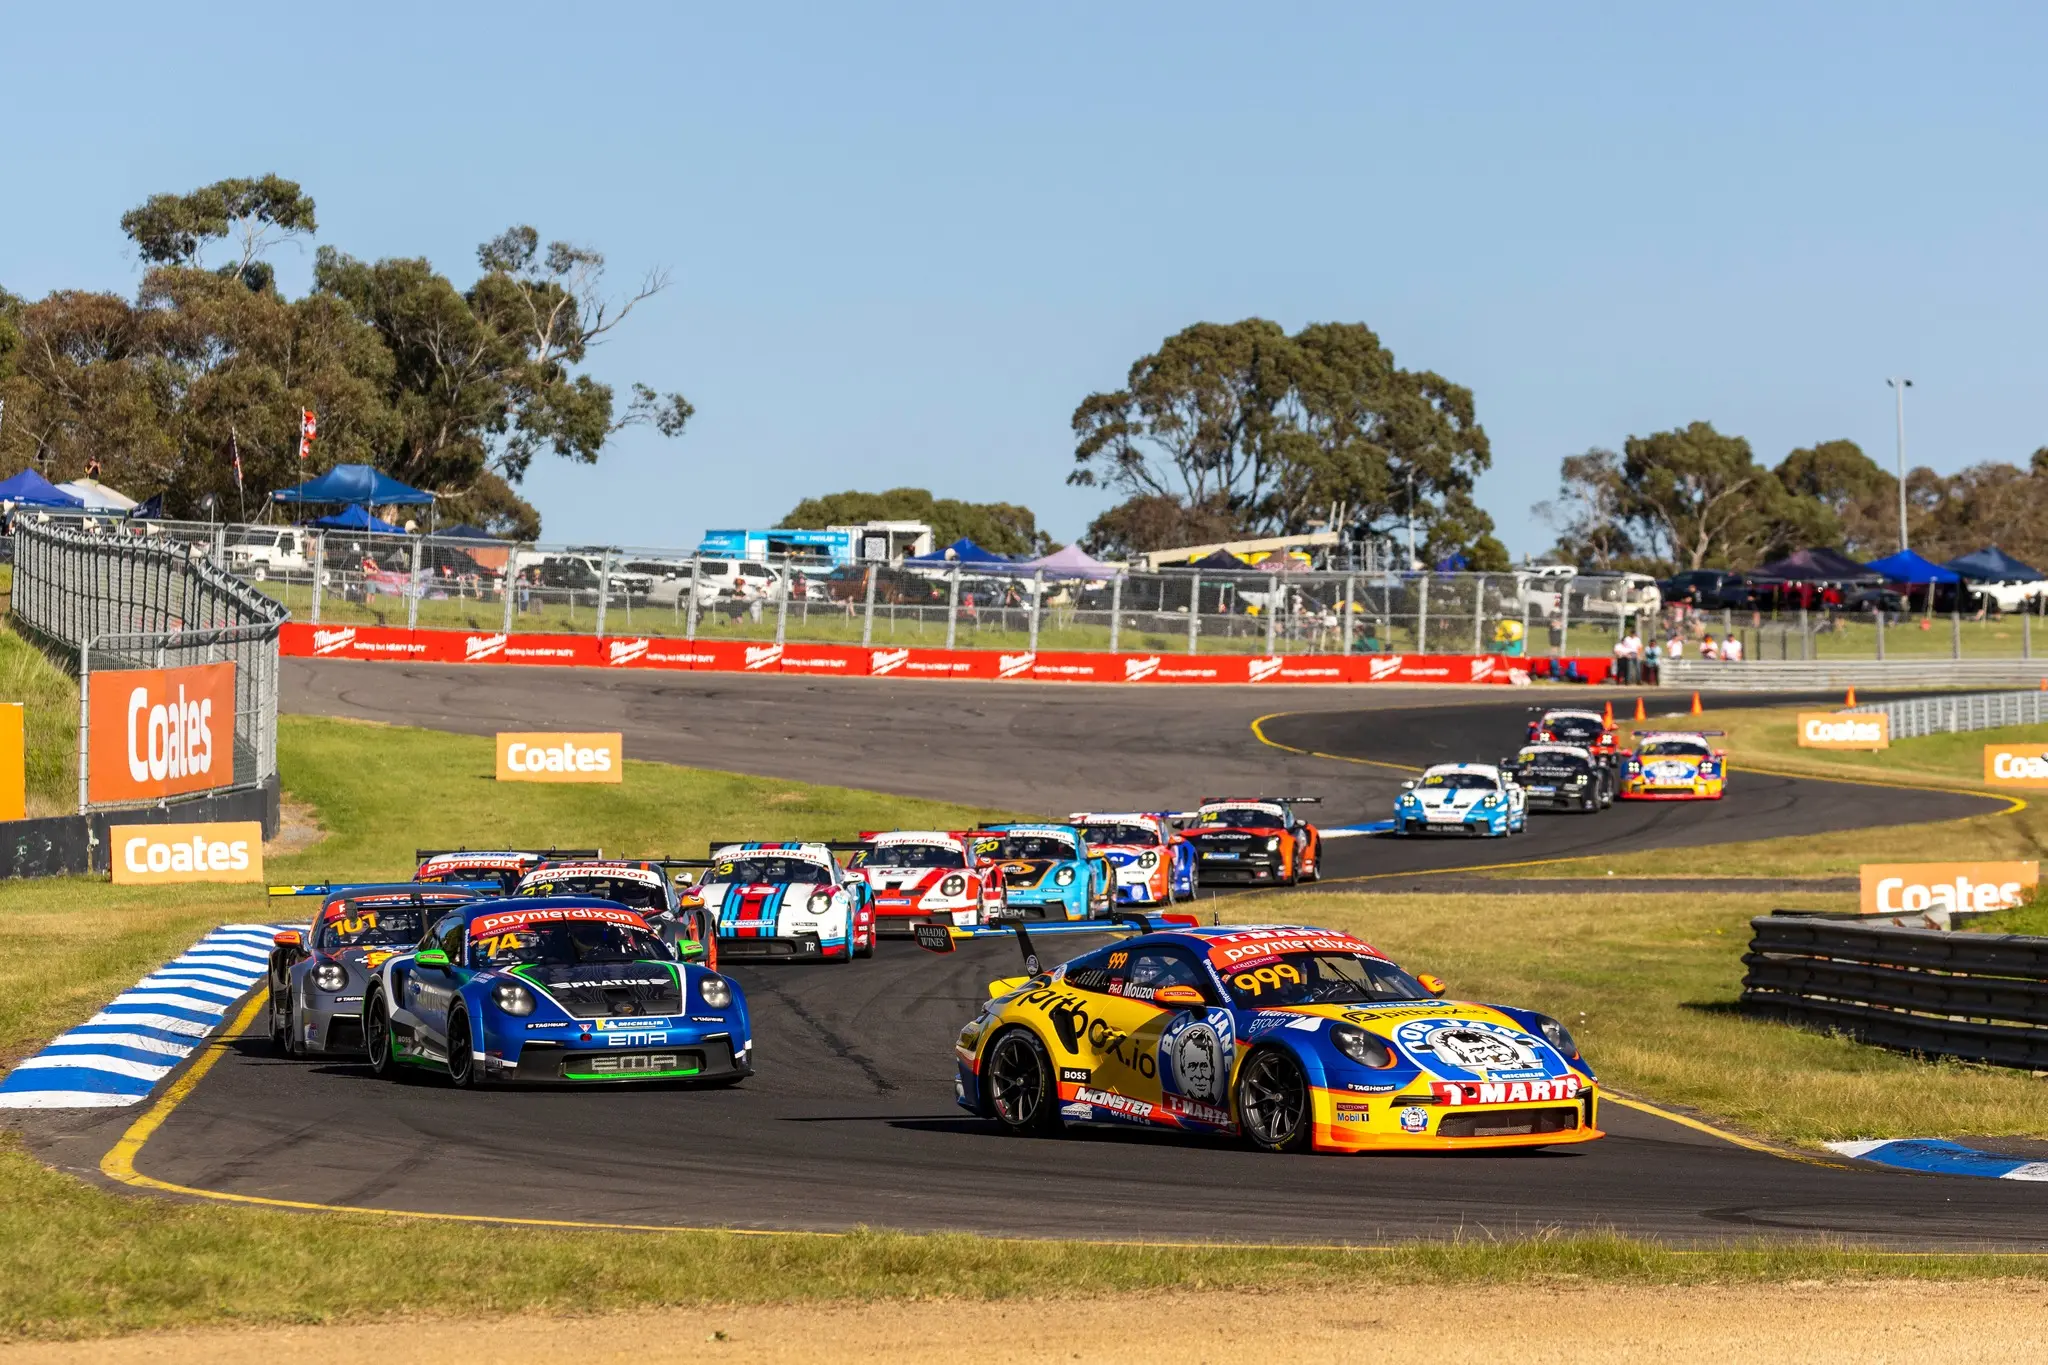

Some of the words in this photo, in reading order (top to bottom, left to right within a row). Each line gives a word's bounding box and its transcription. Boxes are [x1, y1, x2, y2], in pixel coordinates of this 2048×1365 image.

[128, 683, 212, 783] Coates
[1805, 719, 1881, 741] Coates
[508, 741, 611, 773] Coates
[1994, 752, 2048, 778] Coa
[125, 835, 249, 873] Coates
[720, 850, 818, 861] paynterdixon
[976, 841, 999, 854] 20
[533, 866, 649, 881] paynterdixon
[638, 880, 657, 890] Cook
[740, 886, 775, 895] 13
[1876, 875, 2024, 914] Coates
[330, 913, 377, 936] 101
[484, 908, 633, 930] paynterdixon
[606, 921, 649, 933] Patterson
[917, 926, 947, 938] AMADIO
[478, 932, 522, 958] 74
[805, 941, 815, 952] TR
[920, 936, 945, 948] WINES
[1224, 937, 1375, 963] paynterdixon
[1107, 952, 1129, 970] 999
[570, 978, 651, 989] PILATUS
[1234, 964, 1301, 997] 999
[1017, 988, 1157, 1079] pitbox.io
[1248, 1018, 1287, 1034] group
[608, 1032, 667, 1046] EMA
[591, 1054, 677, 1071] EMA
[1064, 1070, 1087, 1080] BOSS
[1501, 1071, 1545, 1079] MICHELIN
[1443, 1077, 1578, 1106] T-MARTS
[1074, 1086, 1154, 1118] MONSTER
[1110, 1110, 1151, 1126] WHEELS
[1169, 1096, 1230, 1127] T-MARTS
[1337, 1113, 1360, 1122] Mobil
